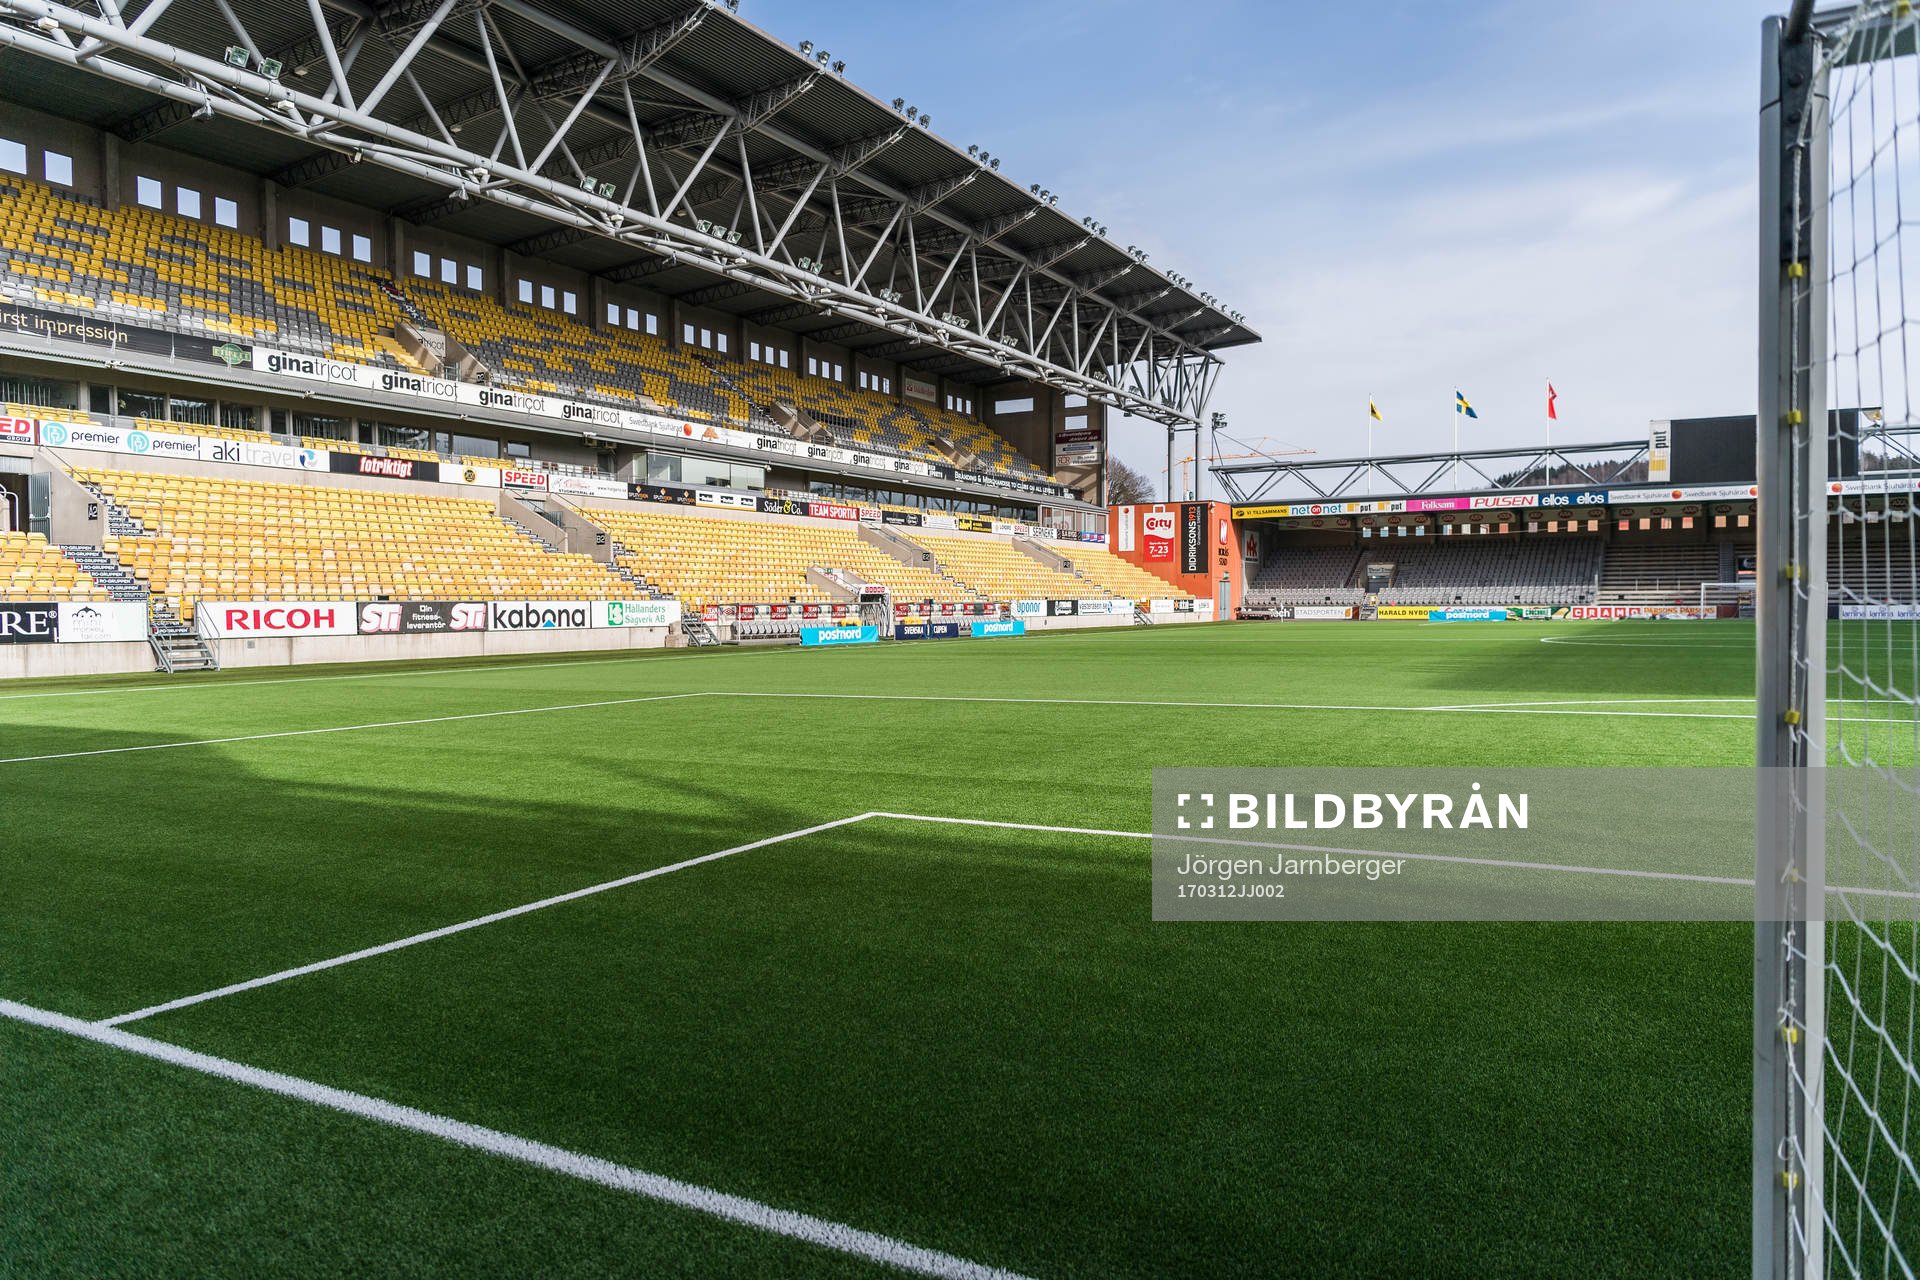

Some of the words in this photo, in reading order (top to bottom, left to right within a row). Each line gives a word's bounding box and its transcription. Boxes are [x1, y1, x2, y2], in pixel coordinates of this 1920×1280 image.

[35, 315, 128, 343] impression
[71, 430, 120, 445] premier
[152, 439, 197, 452] premier
[213, 441, 240, 462] aki
[246, 443, 296, 468] travel
[504, 471, 545, 485] SPEED
[1542, 493, 1569, 506] ellos
[1576, 491, 1604, 505] ellos
[1684, 490, 1718, 498] Swedbank
[764, 501, 783, 514] Söder
[783, 500, 792, 514] &
[791, 503, 803, 515] Co.
[1421, 501, 1455, 509] Folksam
[1474, 496, 1534, 508] PULSEN
[810, 504, 828, 516] TEAM
[829, 505, 857, 519] SPORTIA
[861, 508, 881, 518] SPEED
[1014, 525, 1028, 533] SPEED
[1149, 546, 1169, 554] 7-23
[1017, 601, 1040, 615] uponor
[1446, 610, 1489, 620] postnord
[225, 608, 335, 631] RICOH
[493, 602, 586, 629] kabona
[984, 622, 1013, 633] postnord
[819, 628, 862, 642] postnord
